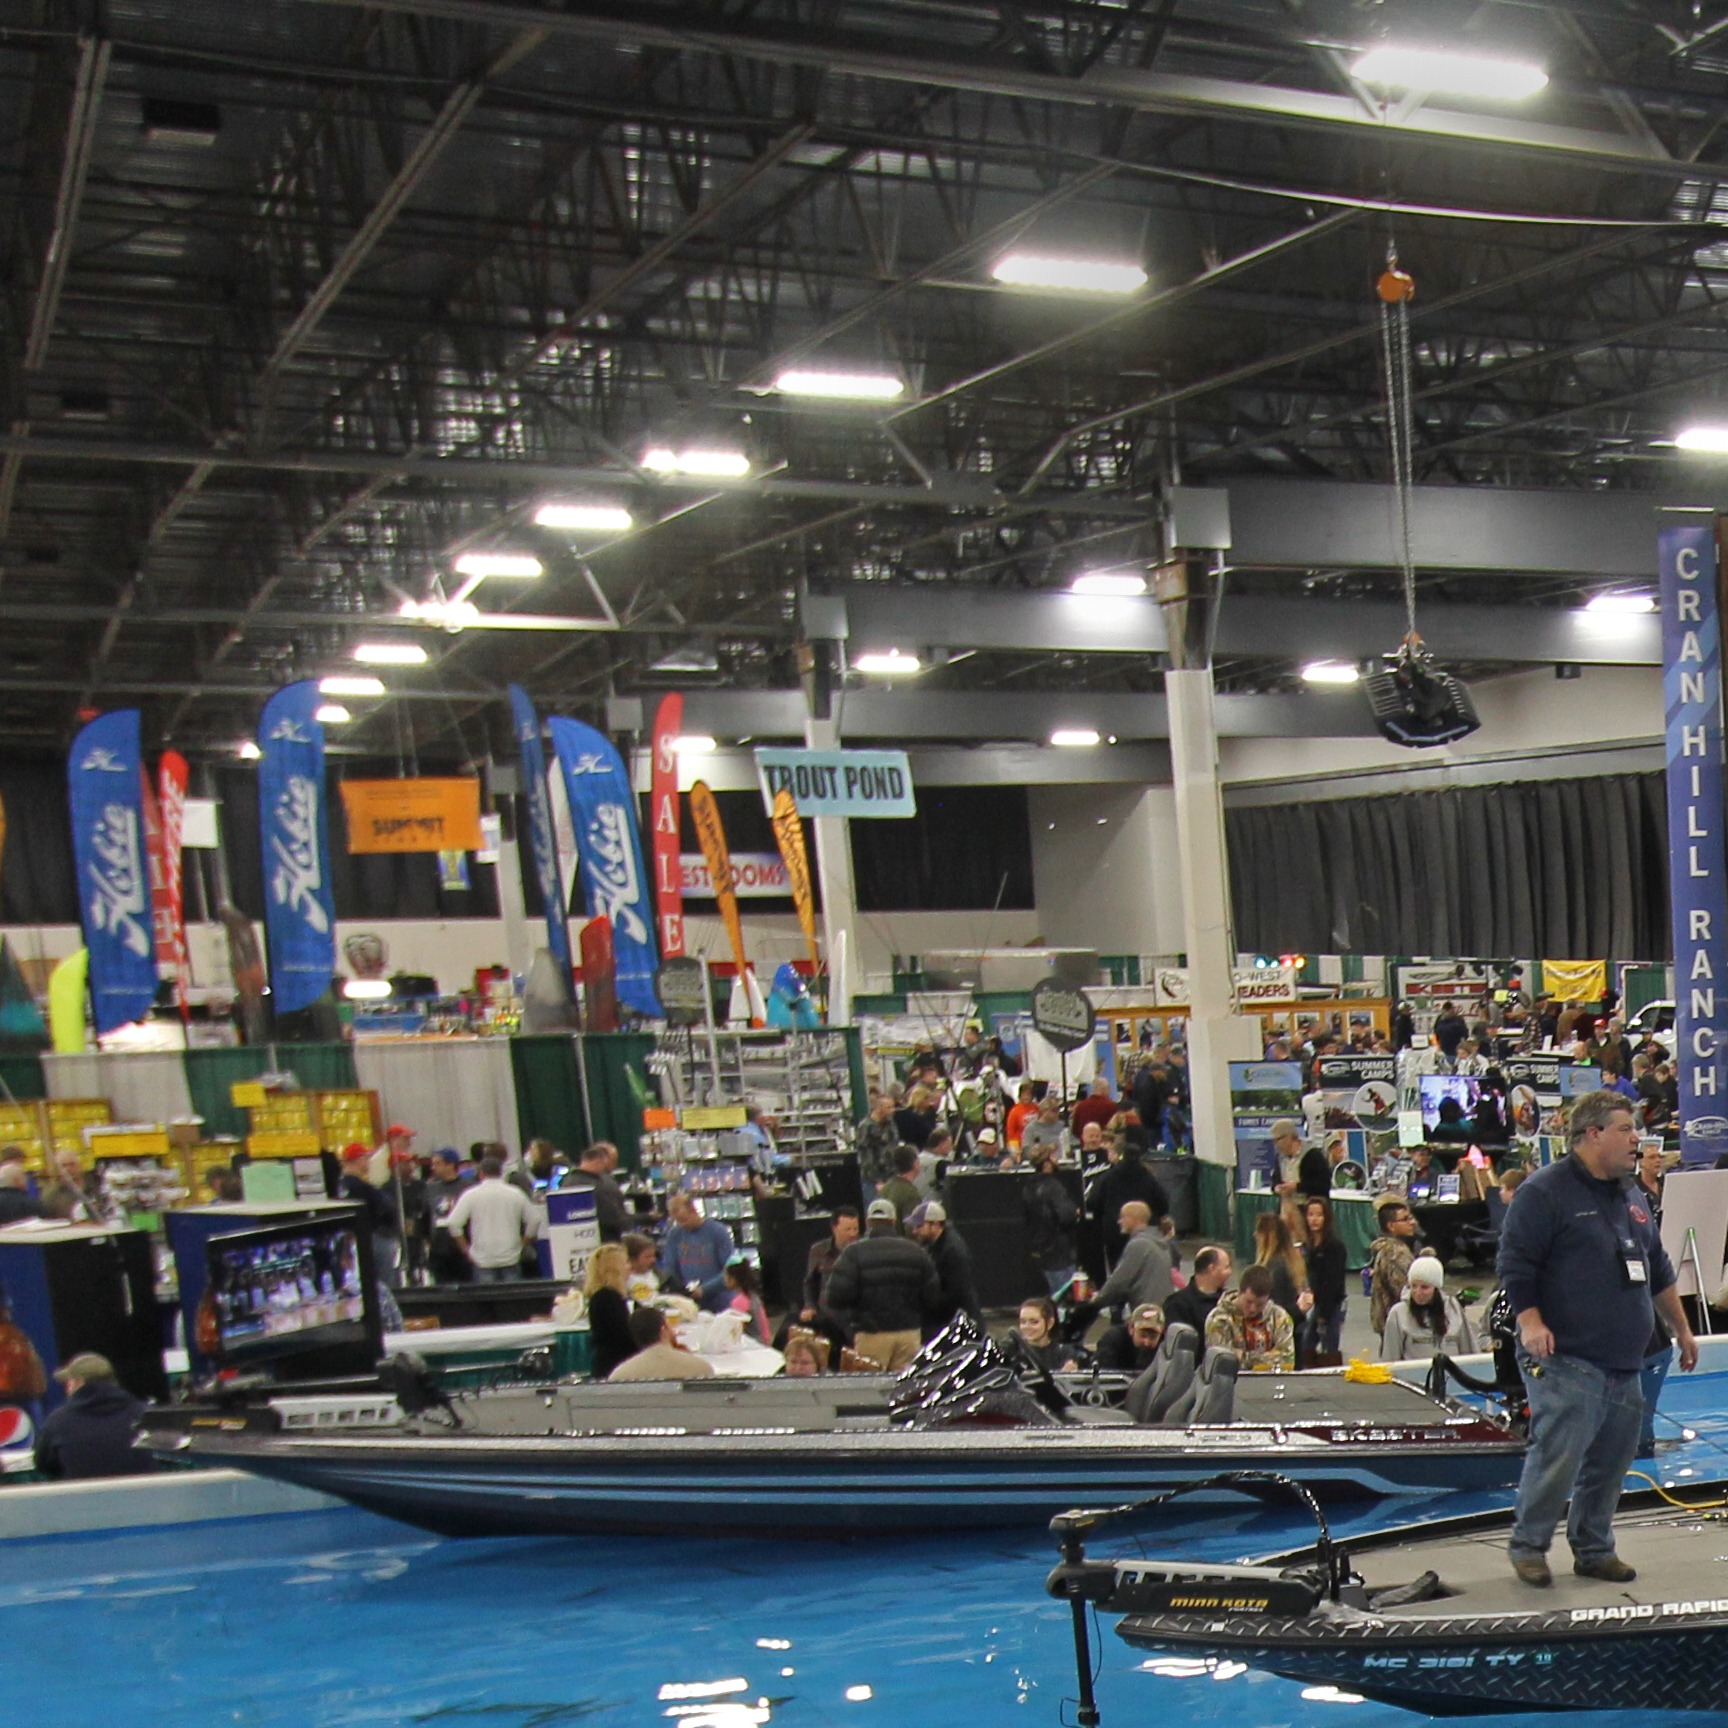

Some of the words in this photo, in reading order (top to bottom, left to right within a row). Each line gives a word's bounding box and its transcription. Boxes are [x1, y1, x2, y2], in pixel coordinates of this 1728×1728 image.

[1675, 547, 1706, 704] CRAN
[763, 765, 838, 801] TROUT
[846, 764, 904, 799] POND
[1682, 725, 1710, 878] HILL
[657, 736, 682, 954] SALE
[681, 863, 785, 889] ESTOOMS
[1688, 910, 1717, 1098] RANCH
[1351, 1060, 1394, 1071] SUMMER
[1361, 1069, 1395, 1080] CAMPS
[1221, 1597, 1270, 1608] KOTA
[1570, 1604, 1654, 1623] GRAND
[1363, 1656, 1408, 1668] MC
[1485, 1653, 1526, 1667] TY
